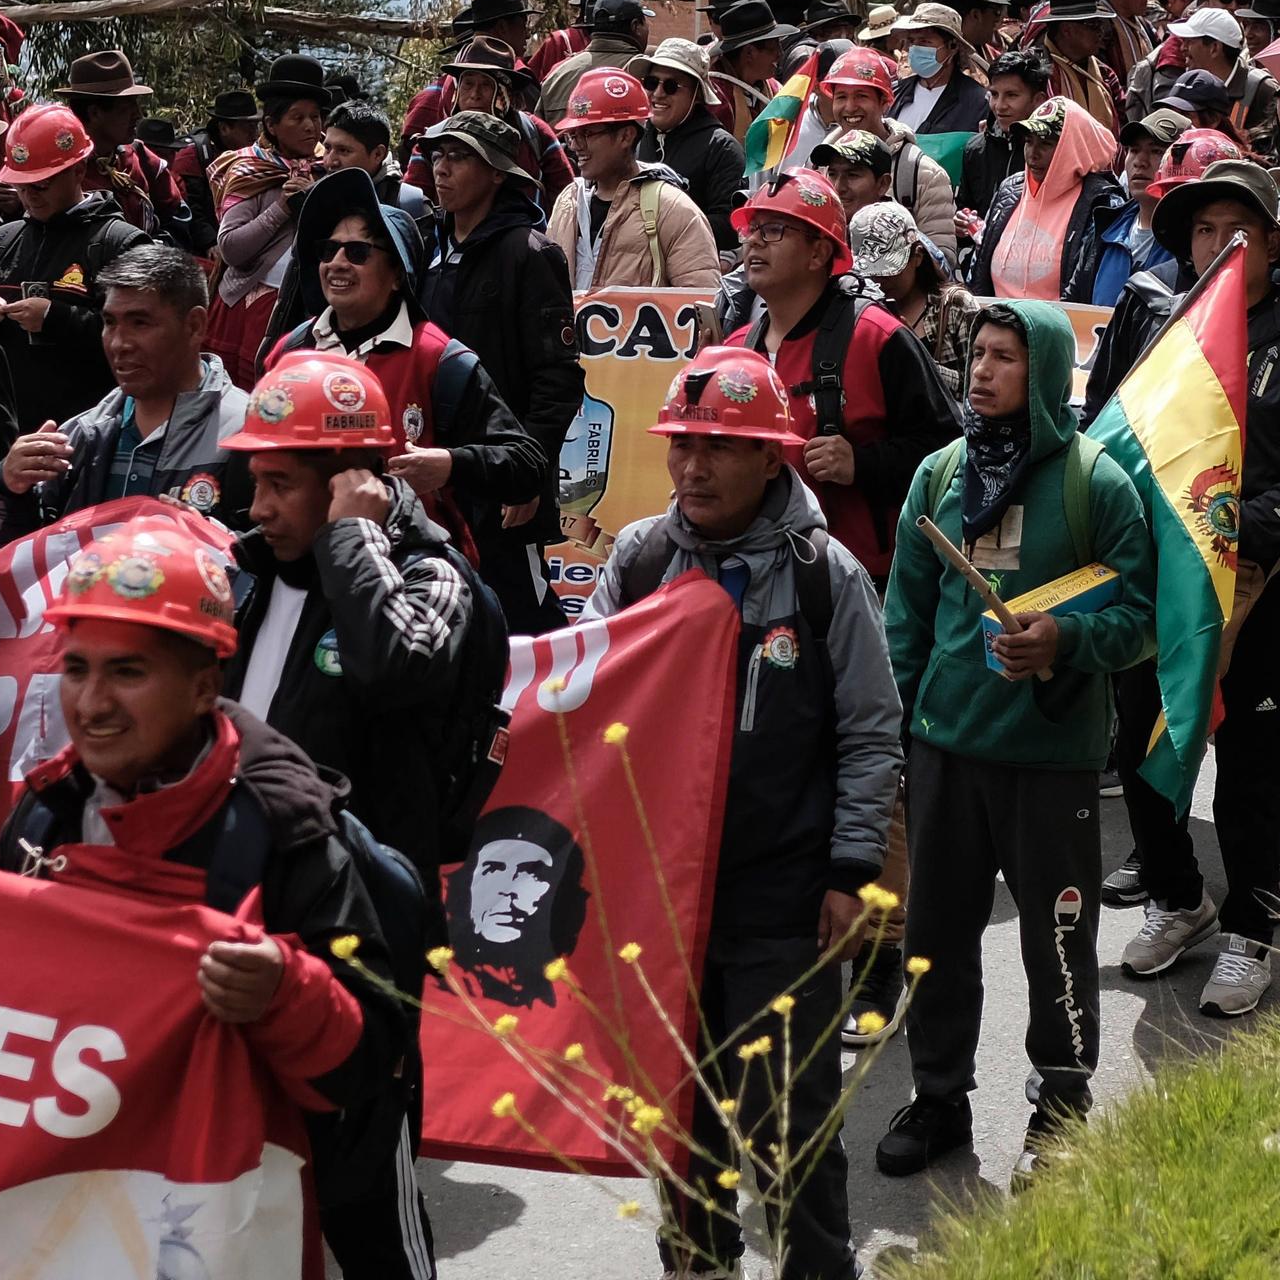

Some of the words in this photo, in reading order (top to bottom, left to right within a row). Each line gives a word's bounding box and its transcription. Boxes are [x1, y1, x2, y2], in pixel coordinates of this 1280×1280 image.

[575, 302, 698, 360] CAT
[325, 415, 376, 429] FABRILES
[586, 422, 603, 487] FABRILES
[560, 516, 577, 529] 17
[1053, 886, 1085, 1058] Champion
